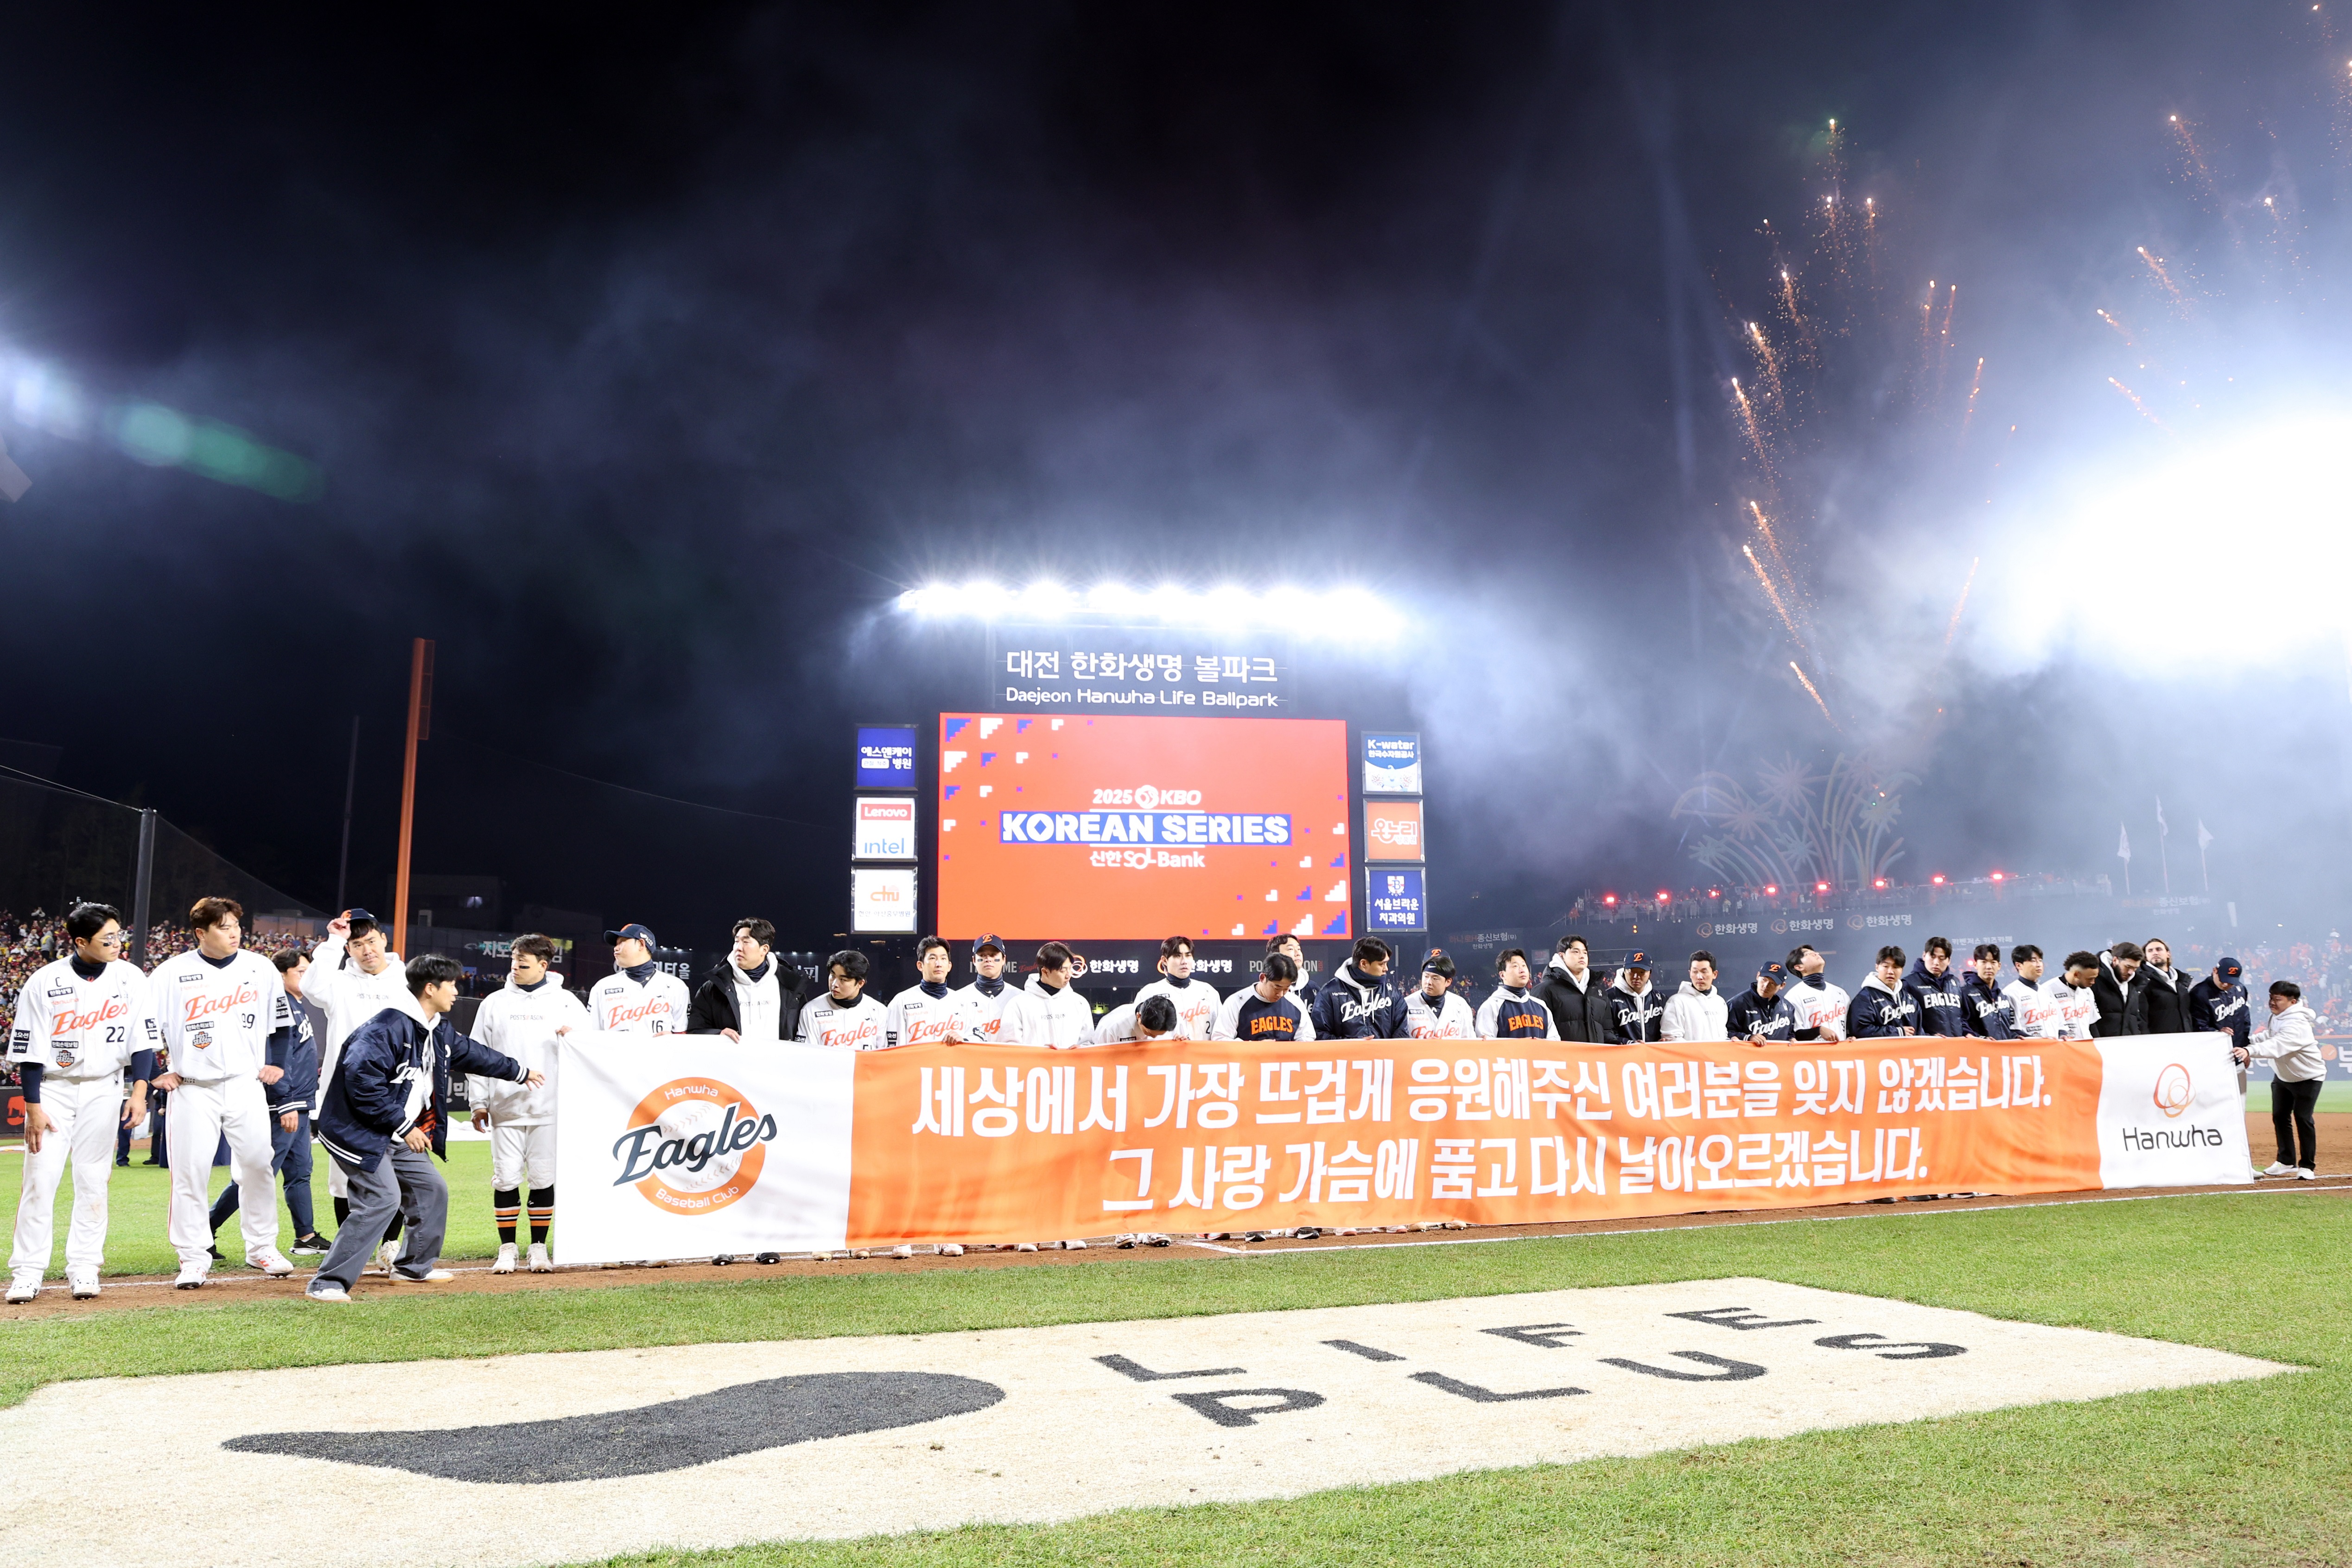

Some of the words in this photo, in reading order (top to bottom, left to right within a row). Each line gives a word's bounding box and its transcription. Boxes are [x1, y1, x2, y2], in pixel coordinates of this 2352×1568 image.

[1007, 650, 1059, 679] 대전
[1070, 653, 1182, 681] 한화생명
[1194, 655, 1278, 683] 볼파크
[1006, 687, 1071, 705] Daejeon
[1077, 689, 1156, 704] Hanwha
[1160, 690, 1195, 705] Life
[1203, 691, 1278, 709] Ballpark
[861, 746, 912, 758] 에스앤케이
[1368, 739, 1415, 749] K-water
[892, 758, 912, 769] 병원
[1093, 789, 1132, 804] 2025
[1160, 789, 1201, 805] KBO
[865, 806, 907, 818] Lenovo
[1003, 813, 1153, 842] KOREAN
[1162, 814, 1289, 844] SERIES
[865, 838, 904, 854] intel
[1090, 851, 1122, 867] 신한
[1374, 898, 1419, 910] 서울브라운
[1379, 913, 1415, 925] 치과의원
[1715, 923, 1758, 934] 한화생명
[1789, 919, 1834, 931] 한화생명
[1866, 915, 1912, 927] 한화생명
[1089, 960, 1139, 973] 한화생명
[55, 977, 62, 987] C
[185, 985, 258, 1022] Eagles
[1341, 994, 1392, 1022] Eagles
[1923, 993, 1961, 1009] EAGLES
[1976, 996, 2010, 1018] Eagles
[2214, 996, 2245, 1022] Eagles
[51, 999, 128, 1036] Eagles
[608, 998, 670, 1029] Eagles
[1508, 1014, 1545, 1031] EAGLES
[1618, 1003, 1663, 1027] Eagles
[1809, 1003, 1846, 1028] Eagles
[1880, 1000, 1915, 1025] Eagles
[106, 1026, 125, 1043] 22
[652, 1021, 663, 1034] 16
[821, 1022, 877, 1047] Eagles
[908, 1015, 964, 1042] Eagles
[1250, 1016, 1293, 1035] EAGLES
[1411, 1020, 1460, 1039] Eagles
[1748, 1013, 1791, 1035] Eagles
[664, 1085, 718, 1100] Hanwha
[912, 1065, 1128, 1137] 세상에서
[1144, 1062, 1245, 1129] 가장
[1256, 1059, 1394, 1124] 뜨겁게
[1408, 1058, 1613, 1121] 응원해주신
[1621, 1060, 1782, 1119] 여러분을
[1793, 1059, 1865, 1115] 잊지
[1877, 1055, 2052, 1114] 않겠습니다.
[613, 1105, 777, 1187] Eagles
[2123, 1124, 2223, 1151] Hanwha
[1103, 1148, 1154, 1211] 그
[1169, 1144, 1271, 1210] 사랑
[1278, 1138, 1418, 1203] 가슴에
[1431, 1137, 1518, 1200] 품고
[1530, 1136, 1607, 1196] 다시
[1620, 1127, 1928, 1195] 날아오르겠습니다.
[655, 1188, 710, 1208] Baseball
[712, 1186, 739, 1203] Club
[1091, 1307, 1822, 1382] LIFE
[1170, 1333, 1968, 1428] PLUS
